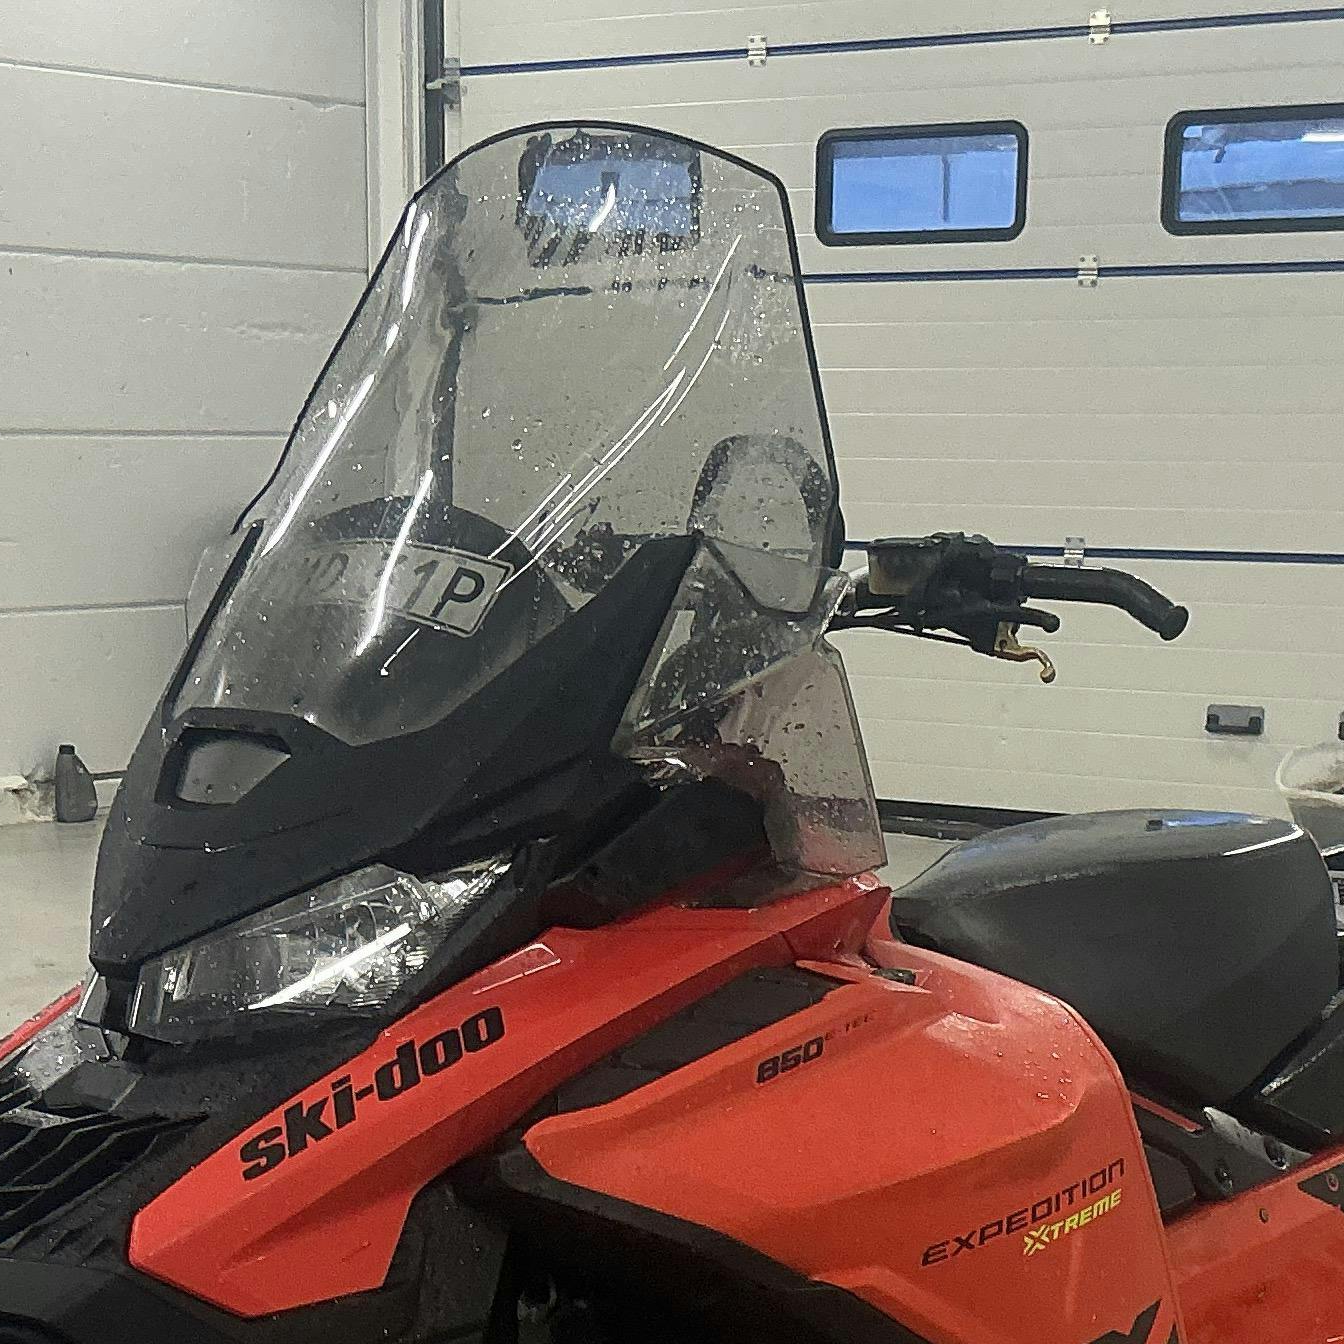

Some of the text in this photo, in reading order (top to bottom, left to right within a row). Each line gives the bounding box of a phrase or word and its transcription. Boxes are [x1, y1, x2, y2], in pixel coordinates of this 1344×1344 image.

[239, 1006, 506, 1181] ski-doo
[756, 1036, 824, 1083] 850
[921, 1157, 1126, 1266] EXPEDITION
[1023, 1189, 1122, 1256] XTREME
